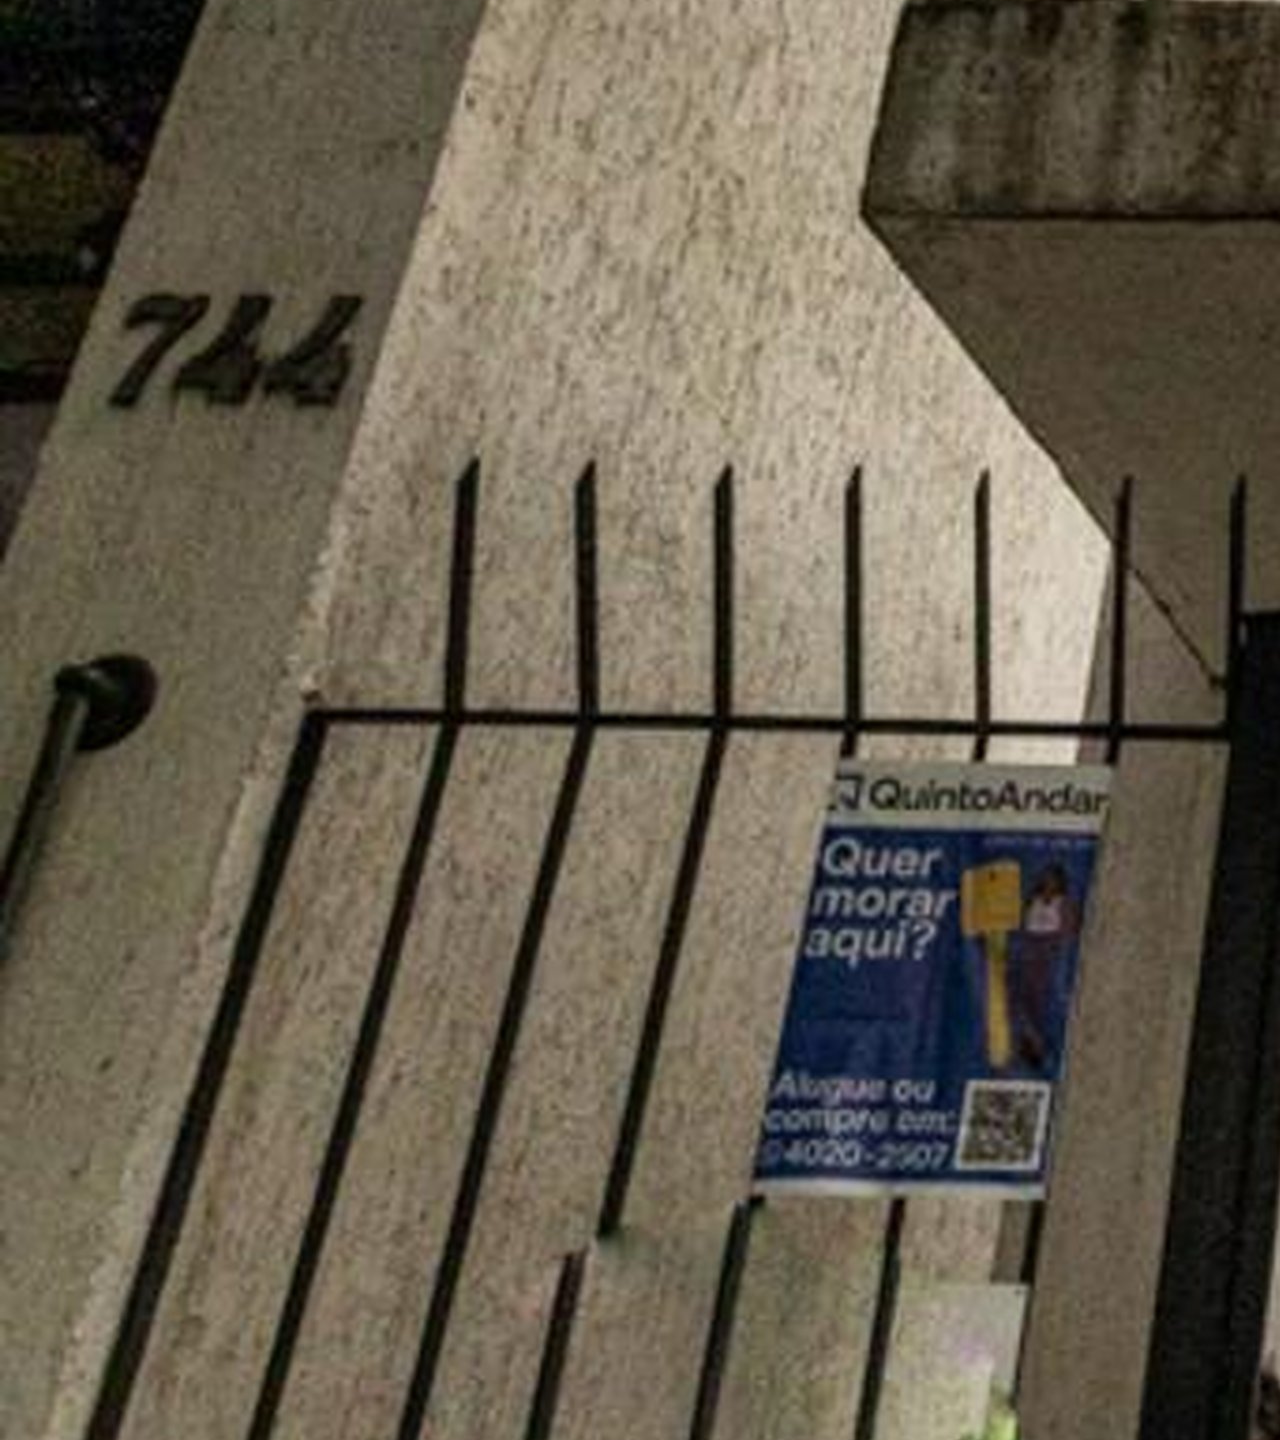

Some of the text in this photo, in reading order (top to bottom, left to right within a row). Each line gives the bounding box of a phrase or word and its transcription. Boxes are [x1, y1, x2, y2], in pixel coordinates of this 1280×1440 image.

[109, 294, 364, 408] 744
[868, 776, 1108, 816] QuintoAndar
[823, 837, 942, 877] Quer
[812, 887, 957, 917] morar
[805, 920, 937, 968] aqui?
